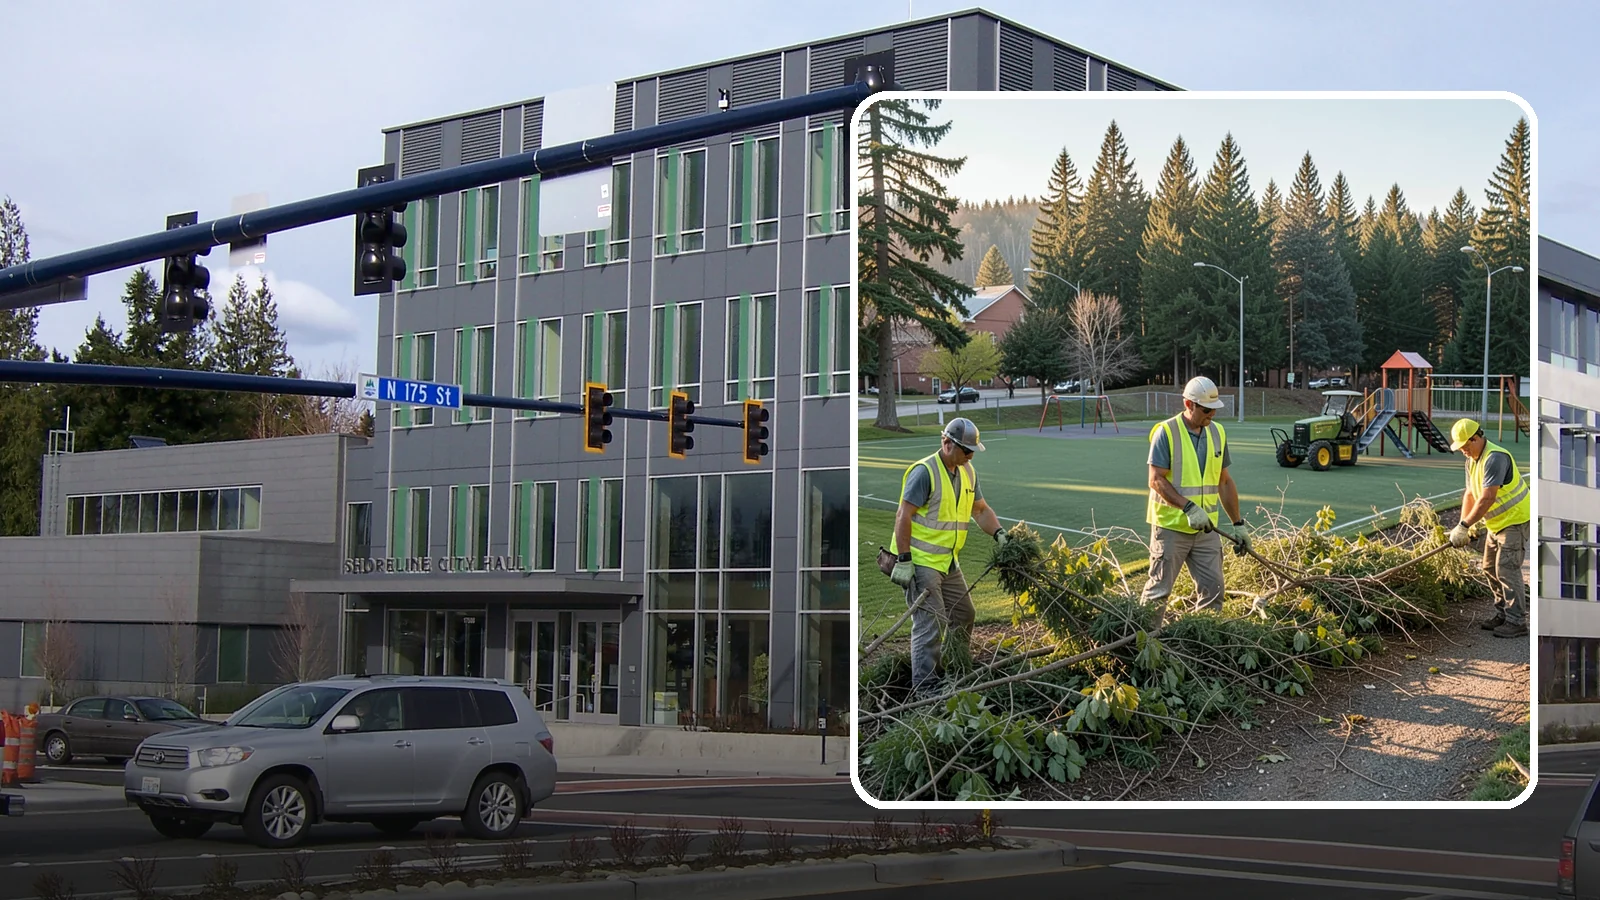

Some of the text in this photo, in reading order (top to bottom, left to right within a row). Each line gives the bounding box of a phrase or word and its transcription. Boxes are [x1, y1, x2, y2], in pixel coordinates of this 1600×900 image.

[387, 380, 451, 406] N 175 St
[344, 555, 525, 574] SHORELINE CITY HALL
